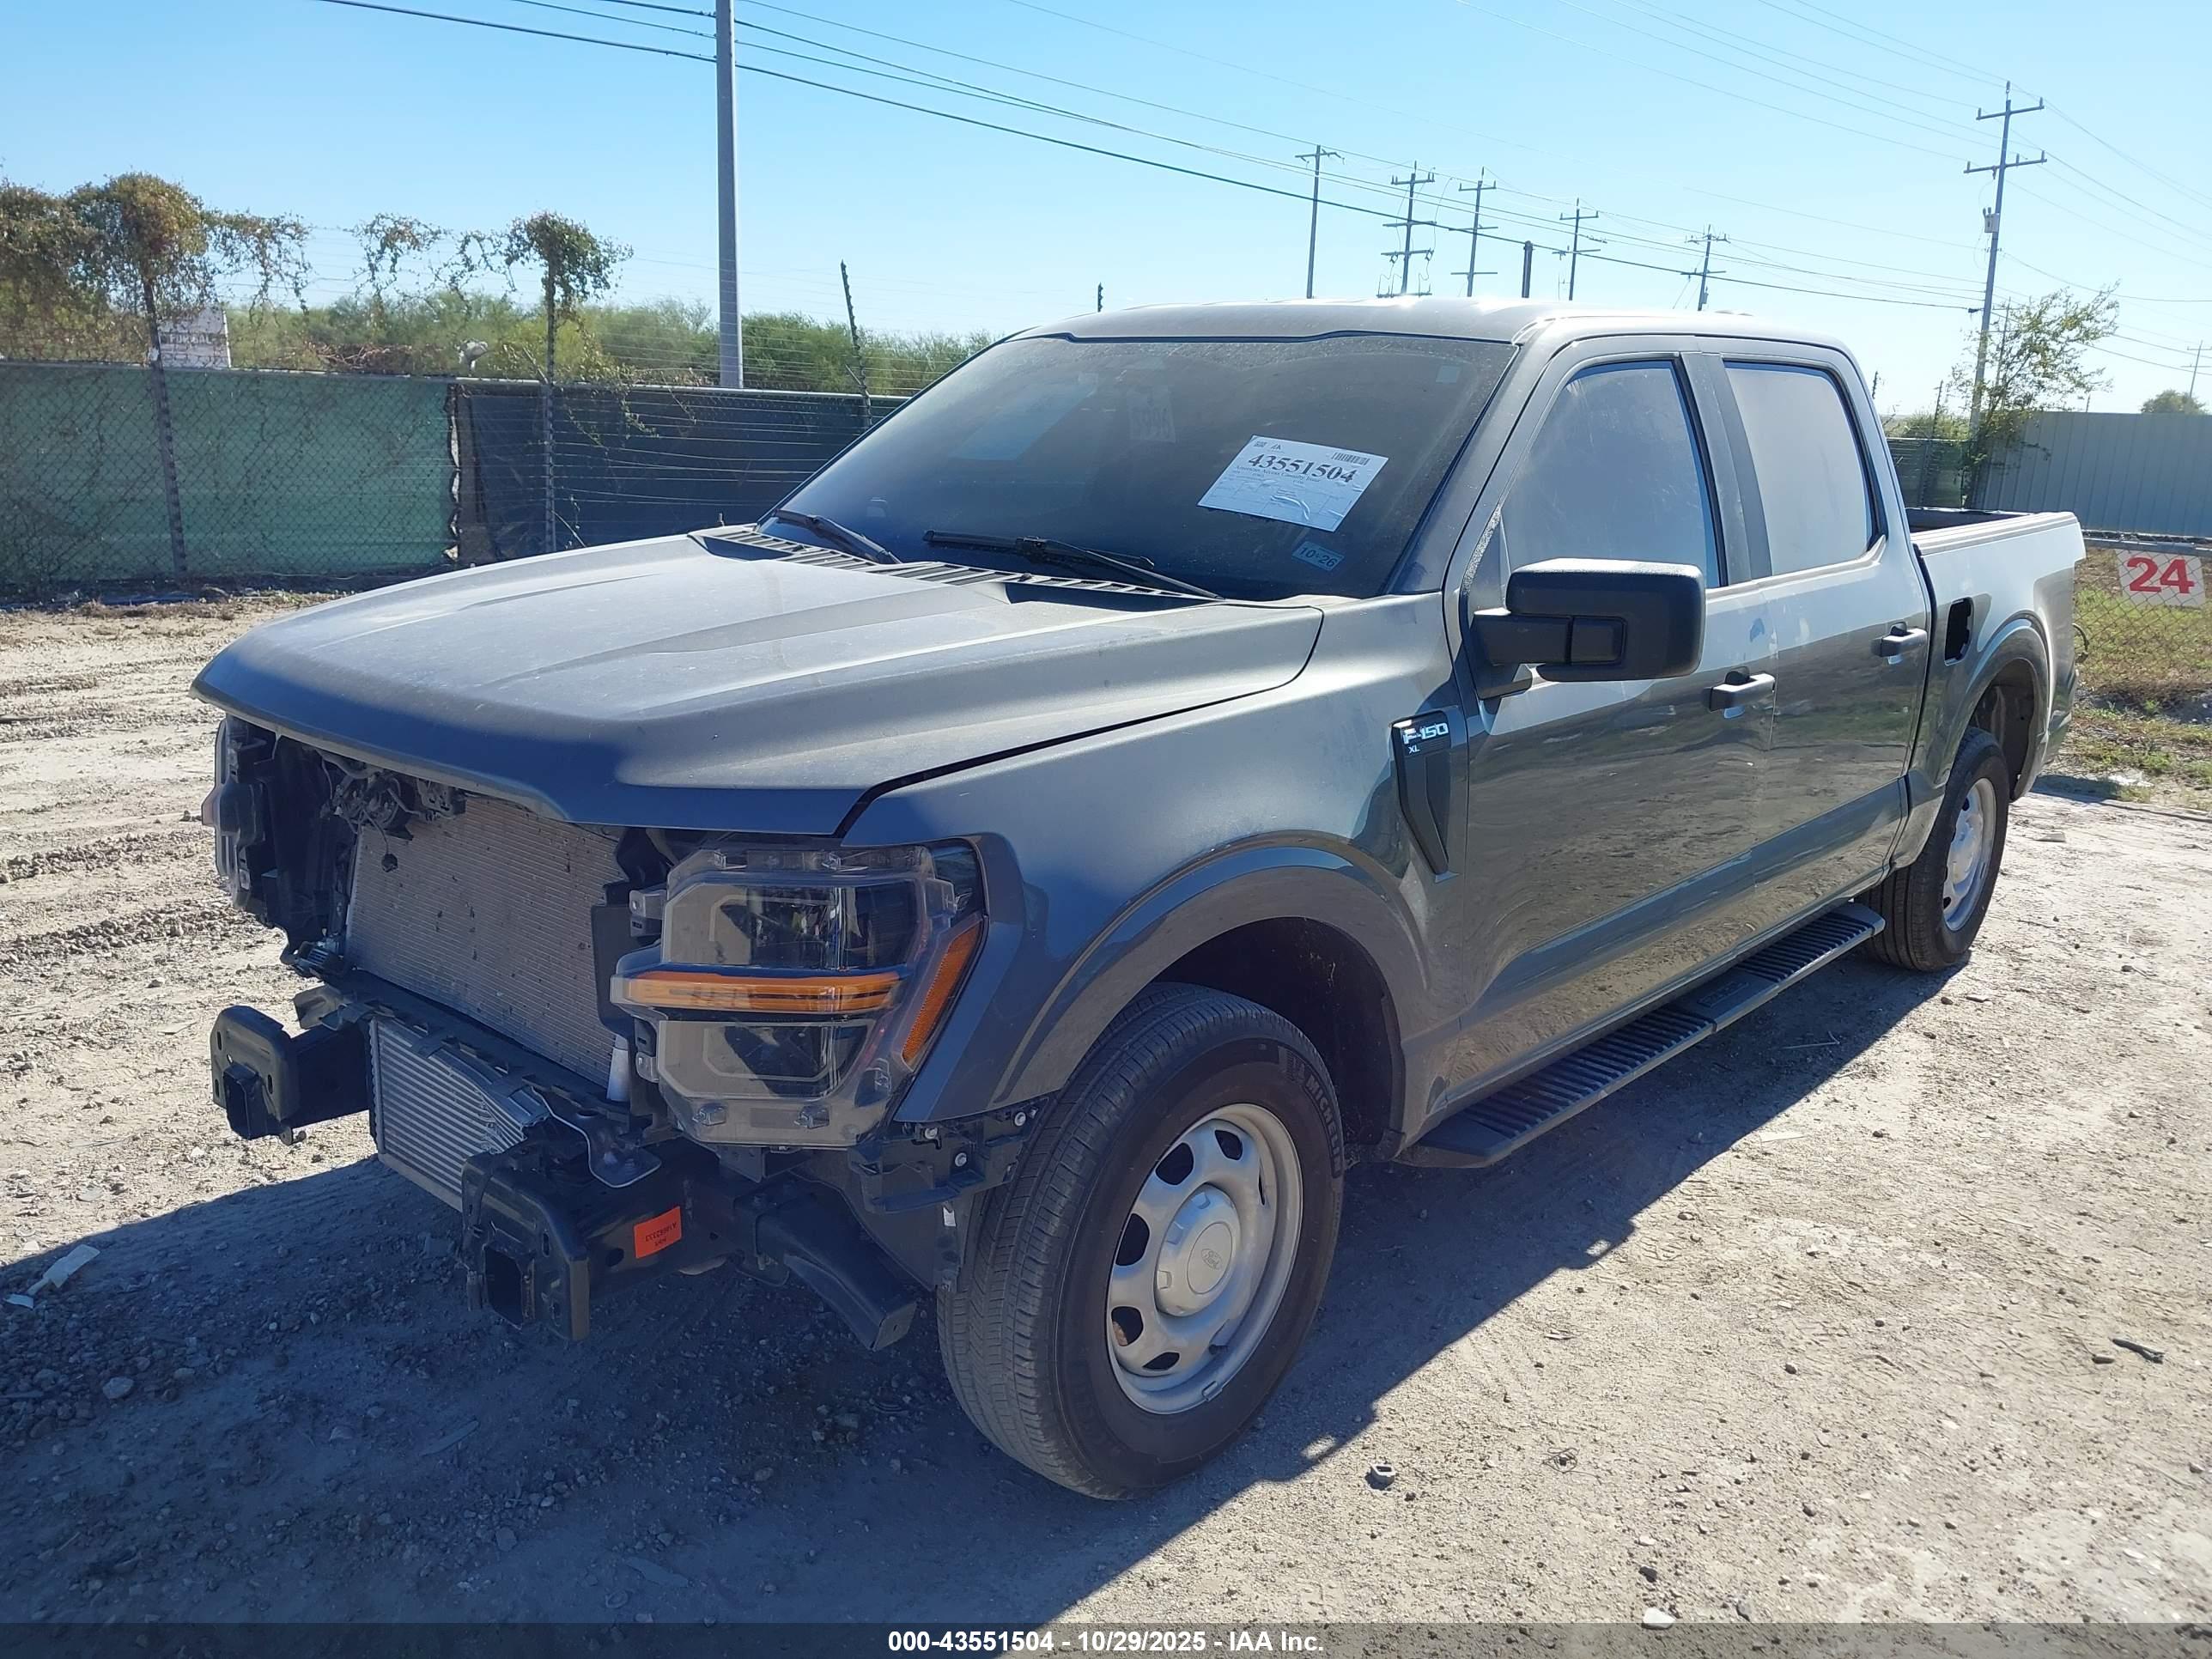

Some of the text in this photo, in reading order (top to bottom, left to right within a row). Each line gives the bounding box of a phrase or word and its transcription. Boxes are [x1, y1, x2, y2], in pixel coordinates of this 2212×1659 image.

[1248, 453, 1358, 483] 43551504
[2127, 556, 2196, 594] 24
[1402, 722, 1449, 744] F-150
[1408, 744, 1419, 754] XL
